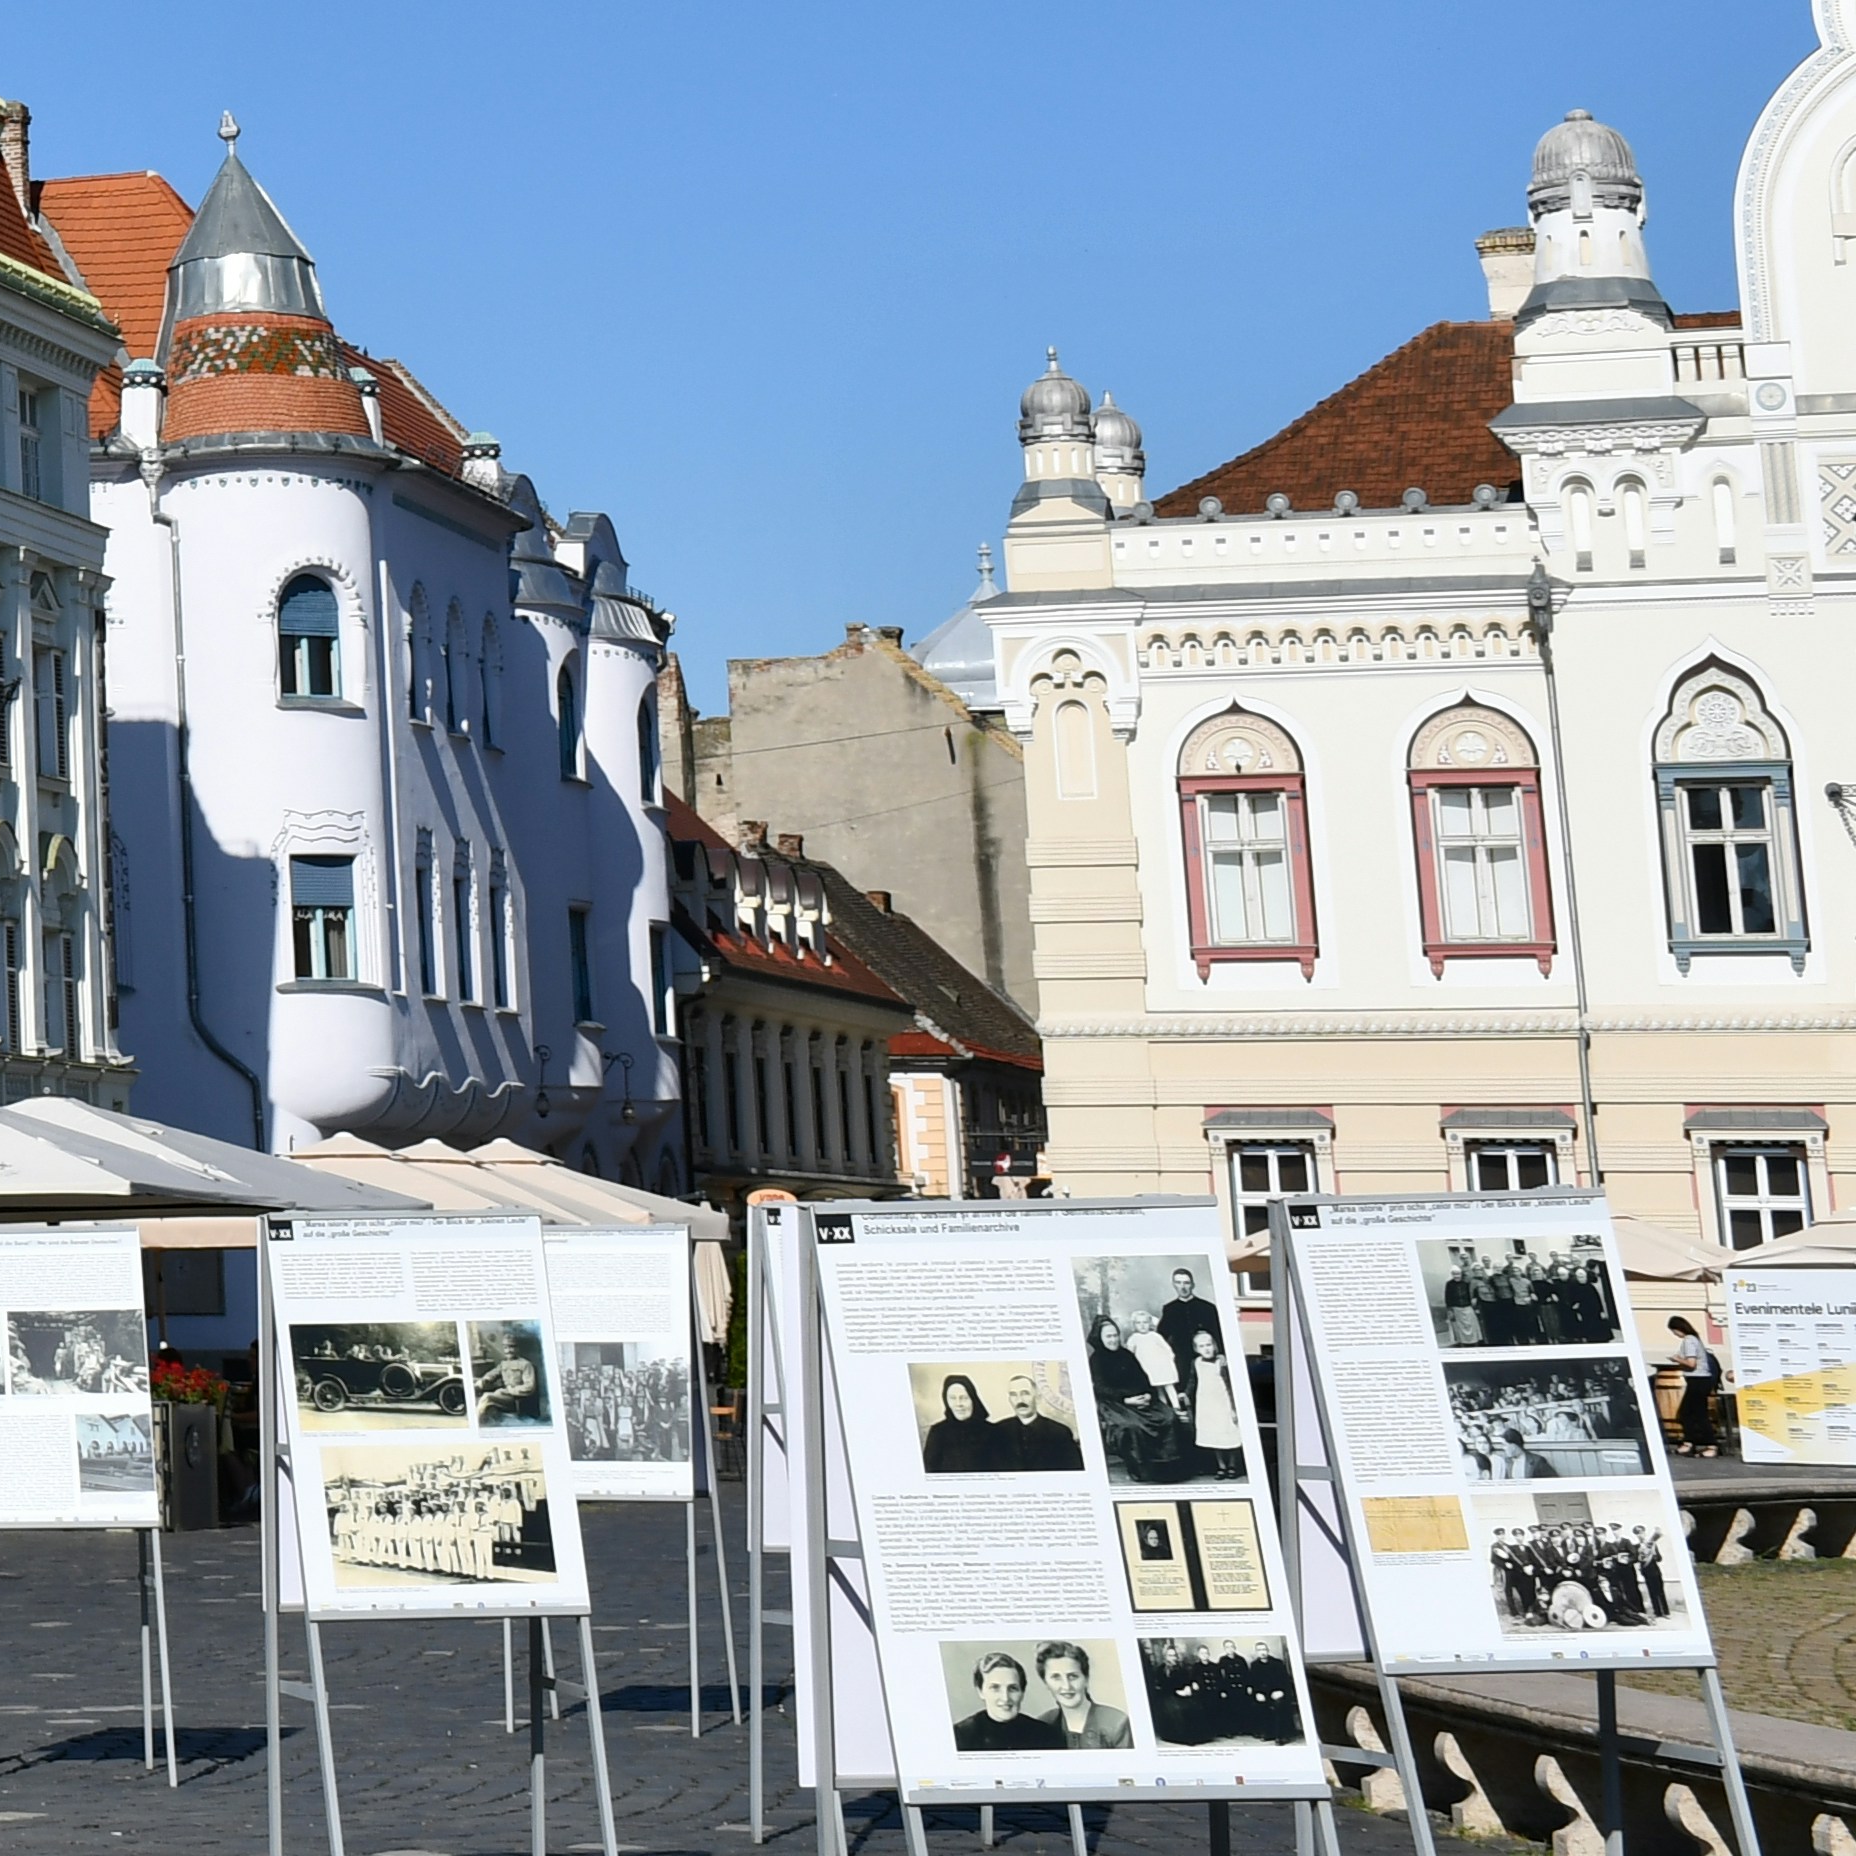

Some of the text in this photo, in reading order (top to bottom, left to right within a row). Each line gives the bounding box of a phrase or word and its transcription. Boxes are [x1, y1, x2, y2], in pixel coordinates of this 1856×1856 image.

[863, 1222, 1020, 1235] Schicksale und Familienarchive
[1735, 1301, 1823, 1315] Evenimentele
